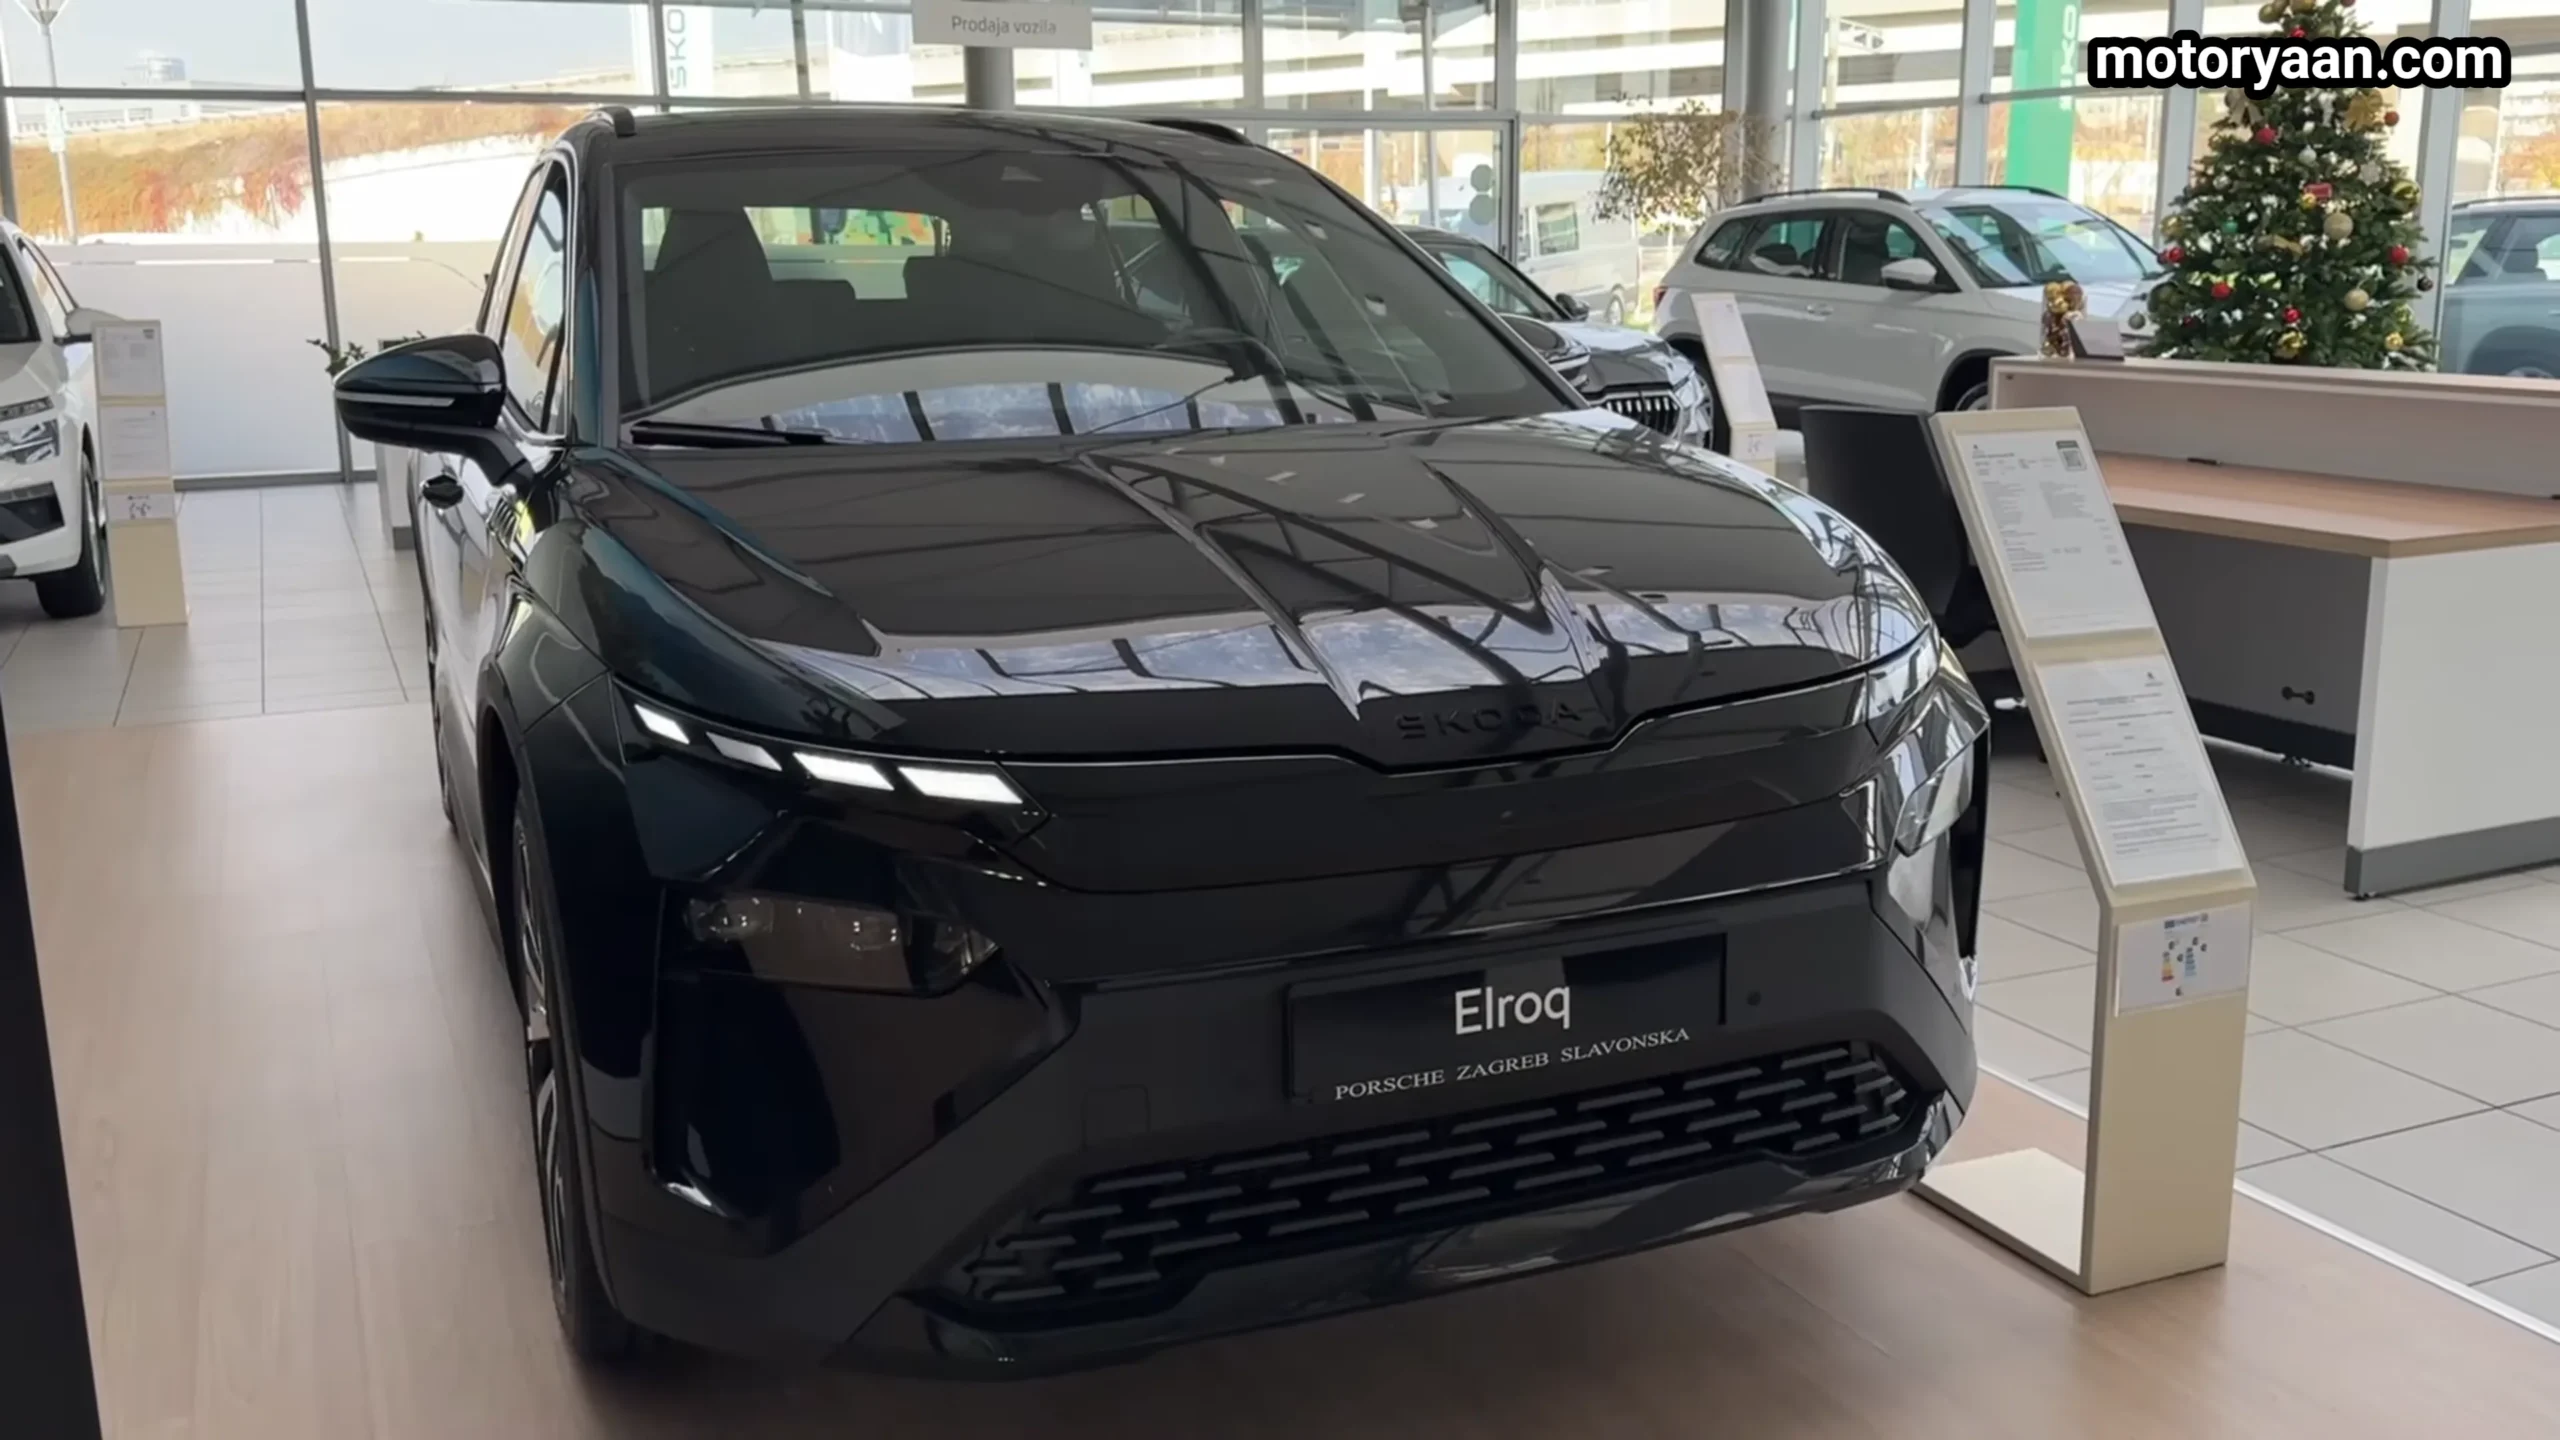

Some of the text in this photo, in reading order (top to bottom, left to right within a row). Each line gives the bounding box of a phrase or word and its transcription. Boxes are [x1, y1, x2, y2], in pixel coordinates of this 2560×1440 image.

[951, 15, 1057, 36] Prodaja vozila
[1455, 986, 1571, 1035] Elroq
[1335, 1027, 1691, 1099] PORSCHE ZAGREB SLAVONSKA
